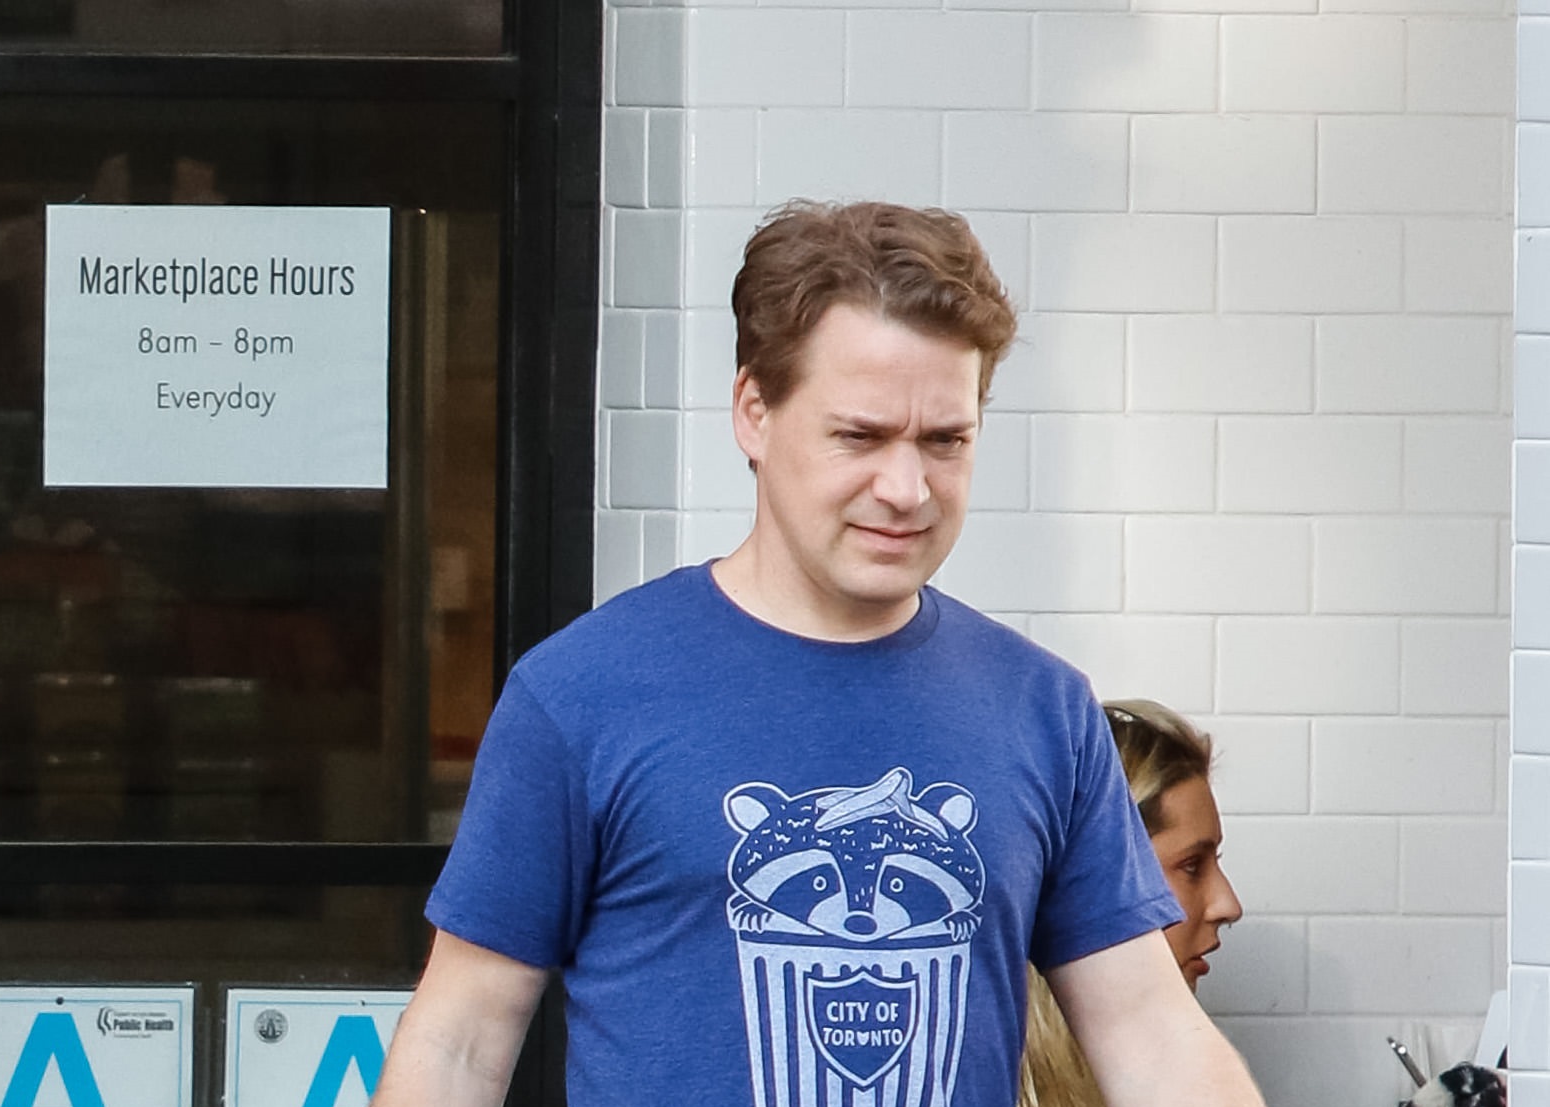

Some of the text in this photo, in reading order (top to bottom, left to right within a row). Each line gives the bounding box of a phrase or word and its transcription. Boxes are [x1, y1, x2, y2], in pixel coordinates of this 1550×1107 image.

[79, 256, 355, 303] Marketplace Hours
[138, 327, 197, 354] 8am
[234, 327, 294, 361] 8pm
[156, 382, 276, 417] Everyday
[825, 1000, 899, 1023] CITY OF
